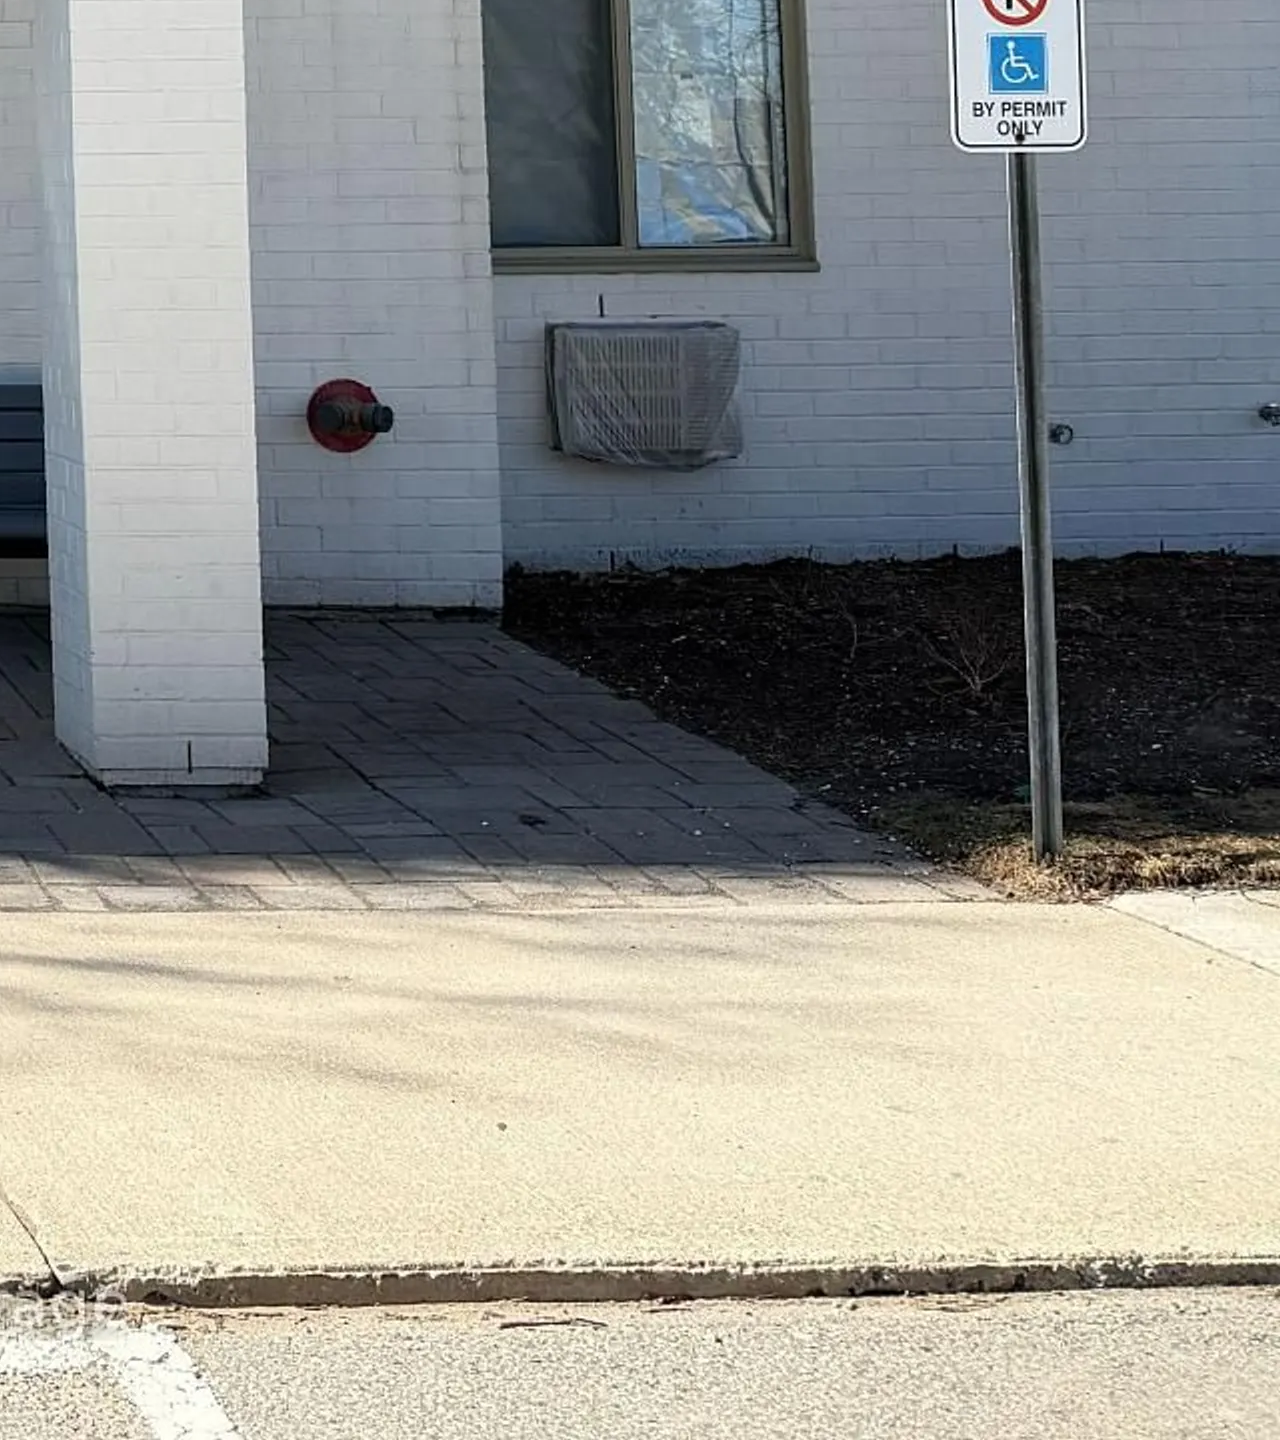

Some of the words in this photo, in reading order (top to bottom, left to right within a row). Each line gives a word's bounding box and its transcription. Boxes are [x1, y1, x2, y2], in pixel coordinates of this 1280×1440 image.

[972, 101, 996, 118] BY
[1001, 100, 1067, 118] PERMIT
[996, 119, 1044, 137] ONLY
